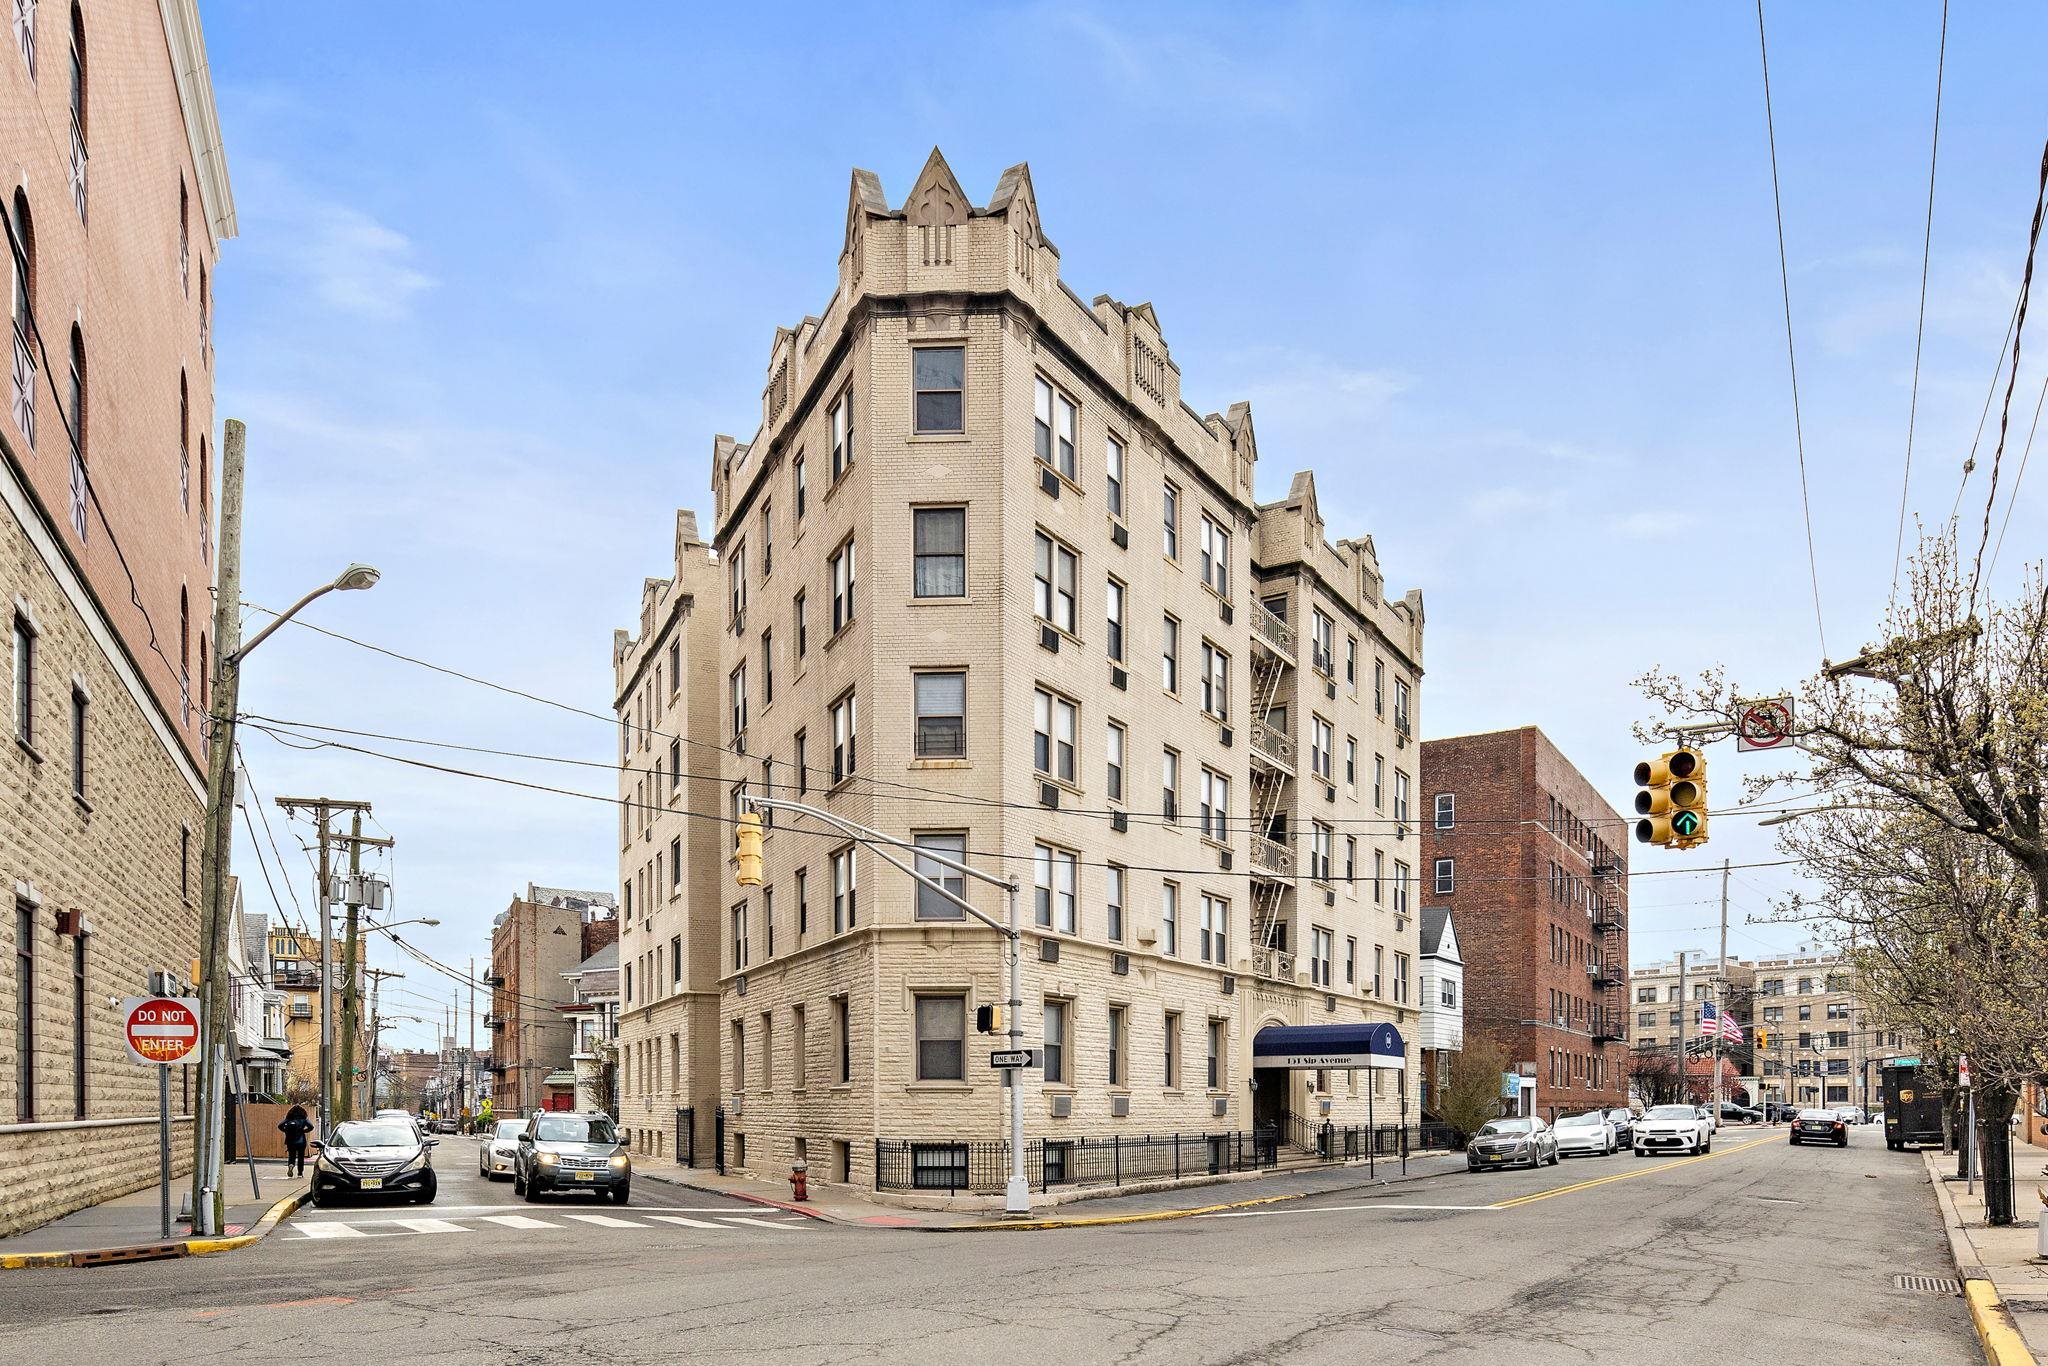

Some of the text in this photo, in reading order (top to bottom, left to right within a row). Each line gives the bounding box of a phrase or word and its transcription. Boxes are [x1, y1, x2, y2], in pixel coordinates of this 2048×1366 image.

[138, 1010, 186, 1022] DO NOT
[142, 1039, 184, 1051] ENTER
[994, 1054, 1024, 1063] ONE WAY
